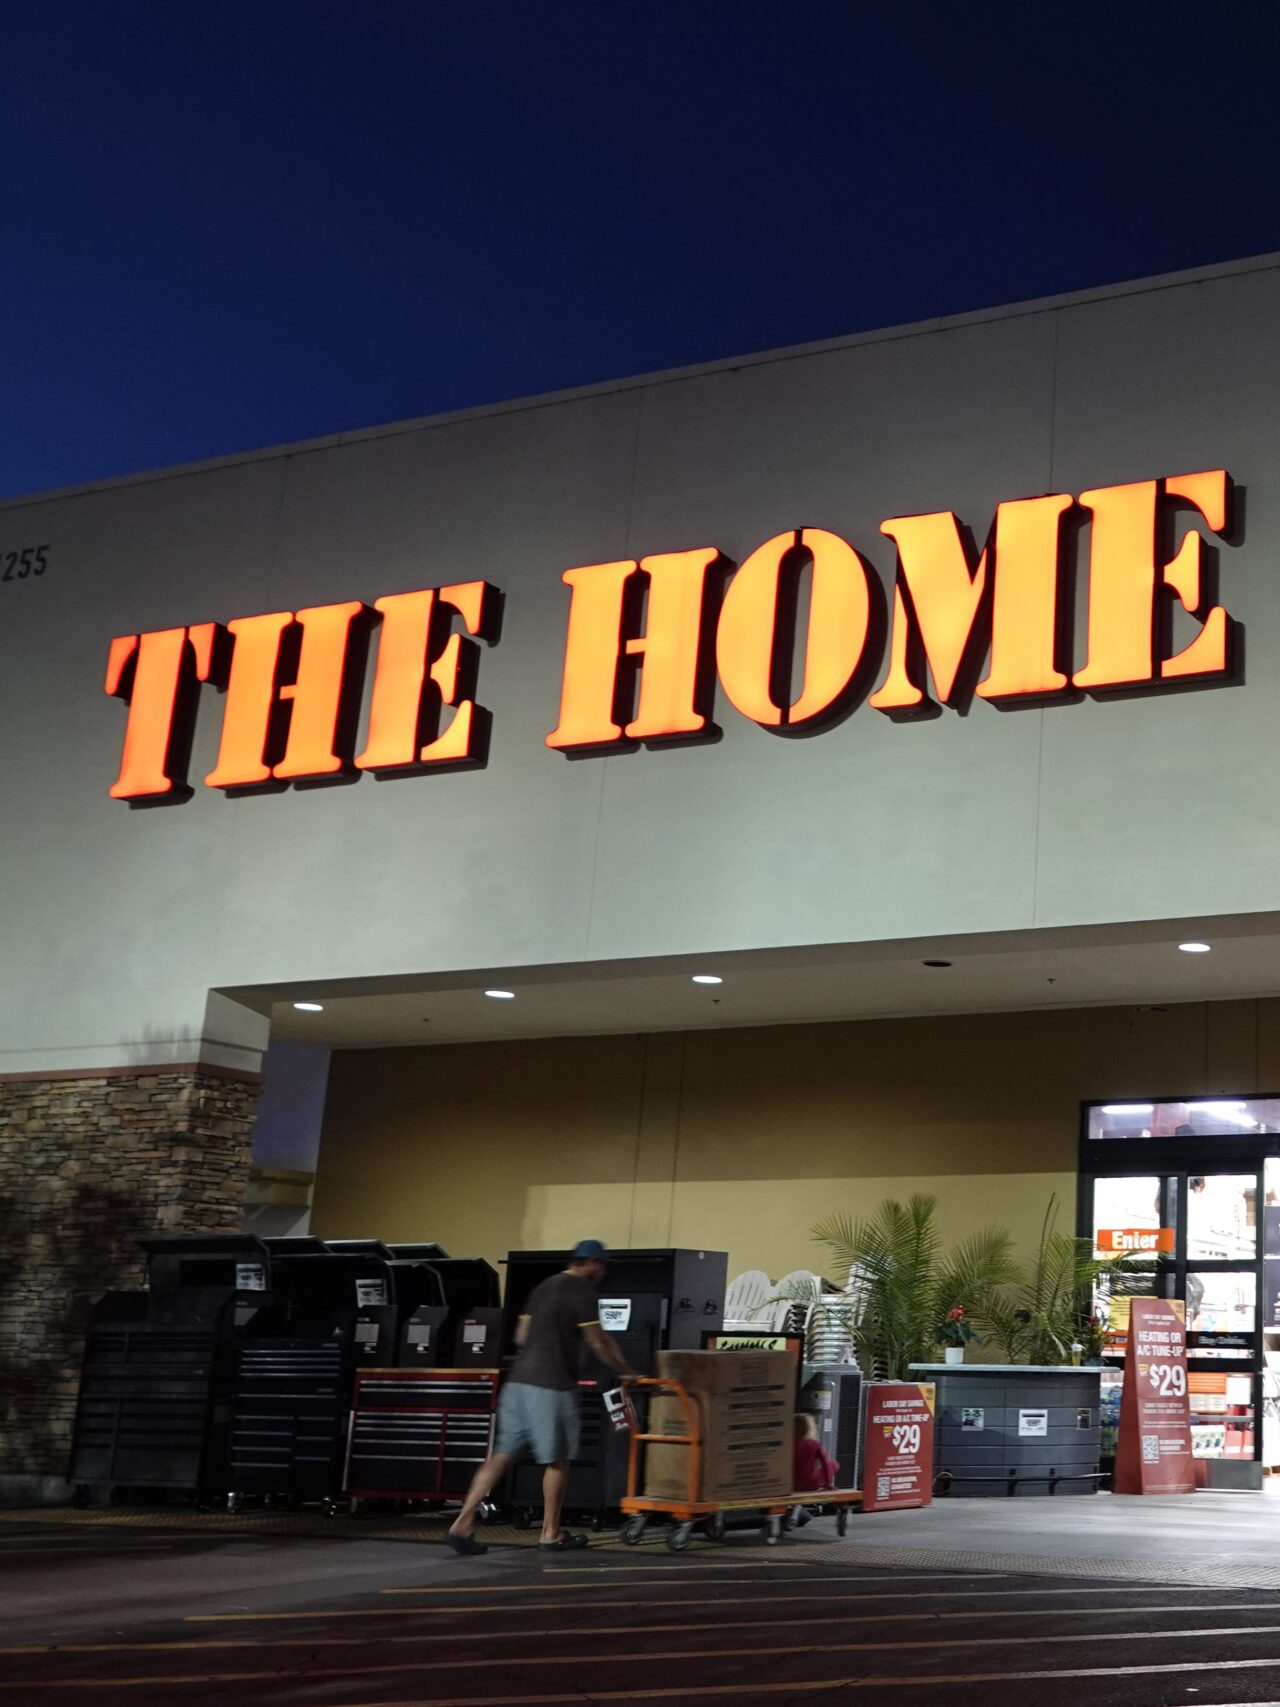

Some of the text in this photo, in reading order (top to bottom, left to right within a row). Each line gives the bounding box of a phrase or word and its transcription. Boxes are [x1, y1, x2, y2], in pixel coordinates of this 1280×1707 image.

[0, 545, 50, 581] 255
[105, 581, 486, 799] THE
[545, 470, 1228, 748] HOME
[1111, 1230, 1159, 1250] Enter
[1136, 1344, 1151, 1356] A/C
[1138, 1330, 1182, 1344] HEATING OR
[1149, 1363, 1186, 1396] $29
[892, 1423, 921, 1454] $29
